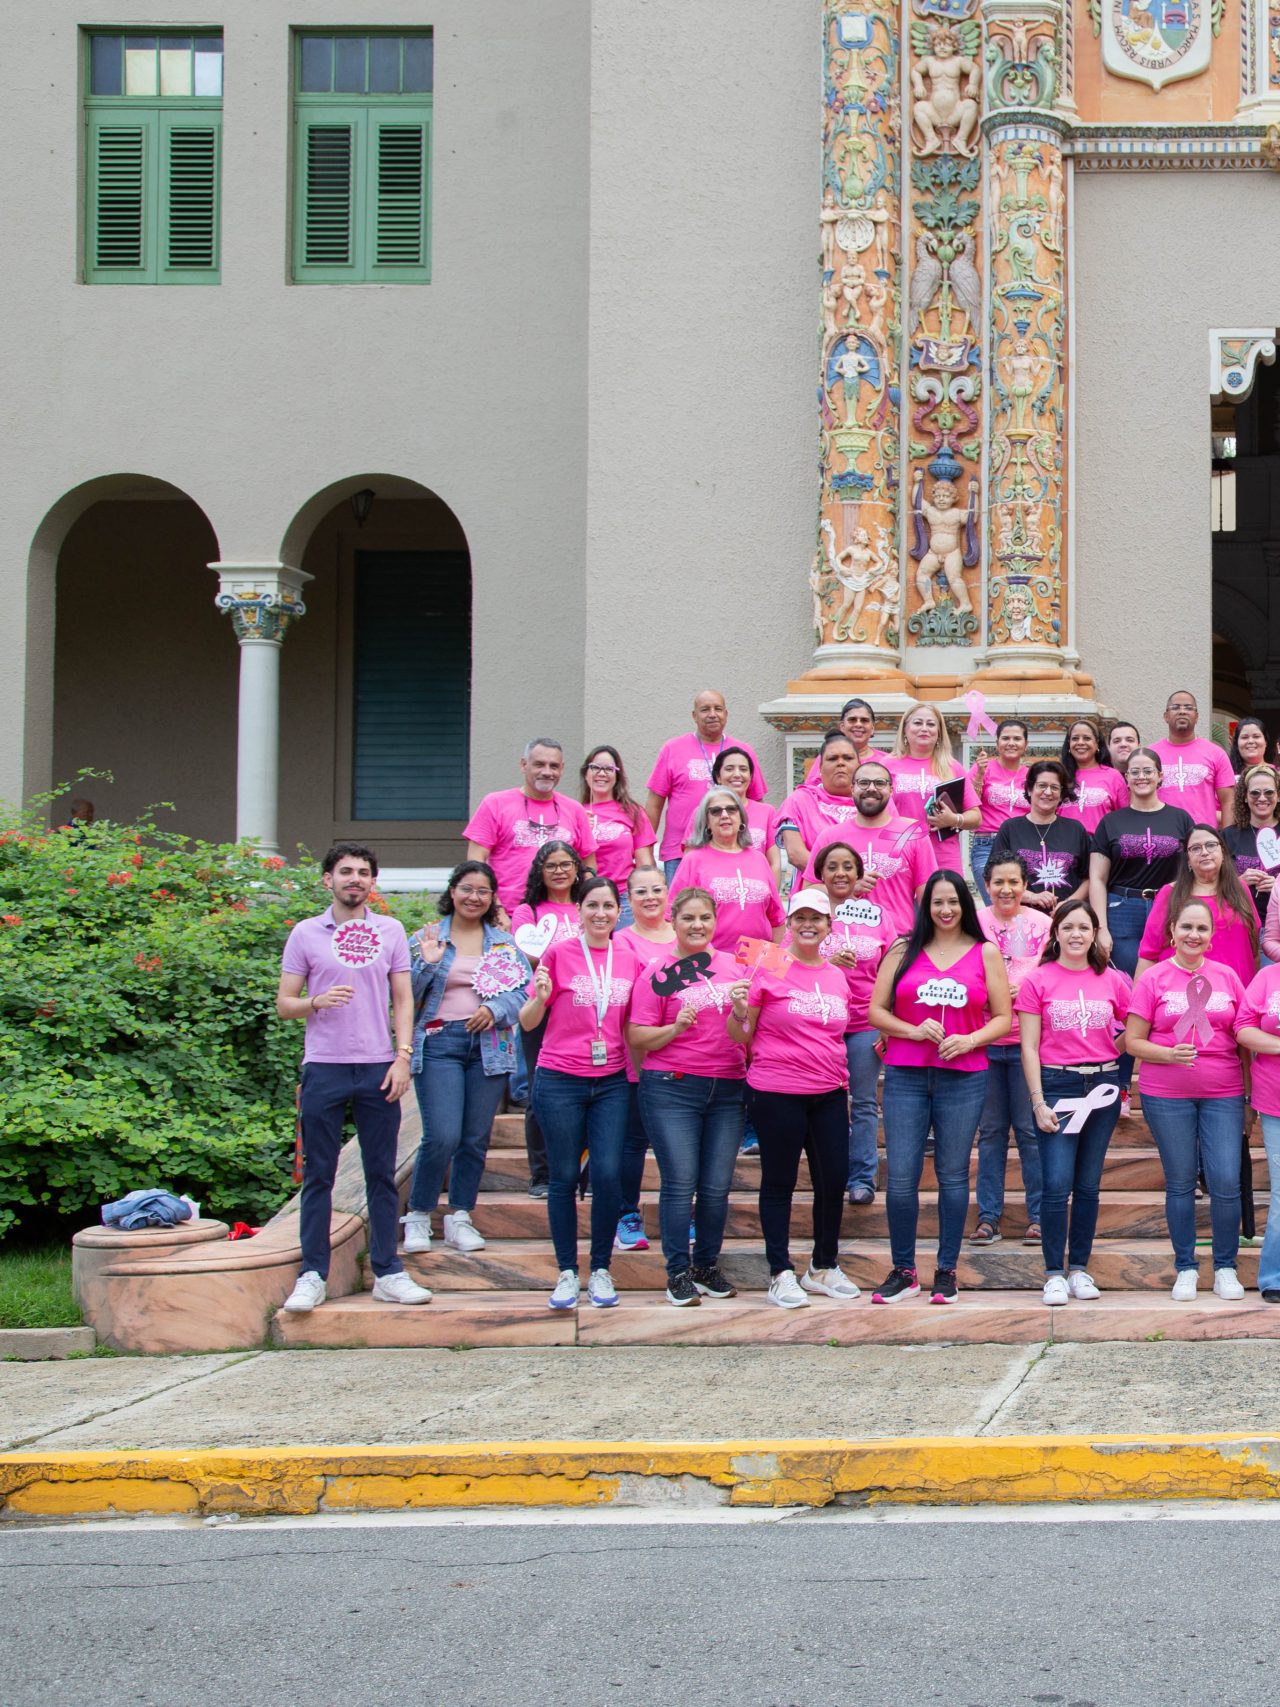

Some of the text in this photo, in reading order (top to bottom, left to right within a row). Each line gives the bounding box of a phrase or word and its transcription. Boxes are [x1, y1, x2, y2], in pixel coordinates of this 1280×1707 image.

[1176, 25, 1200, 57] MARCI
[1140, 57, 1173, 69] VRBIS
[345, 932, 370, 945] ZAP
[650, 951, 717, 997] UPR
